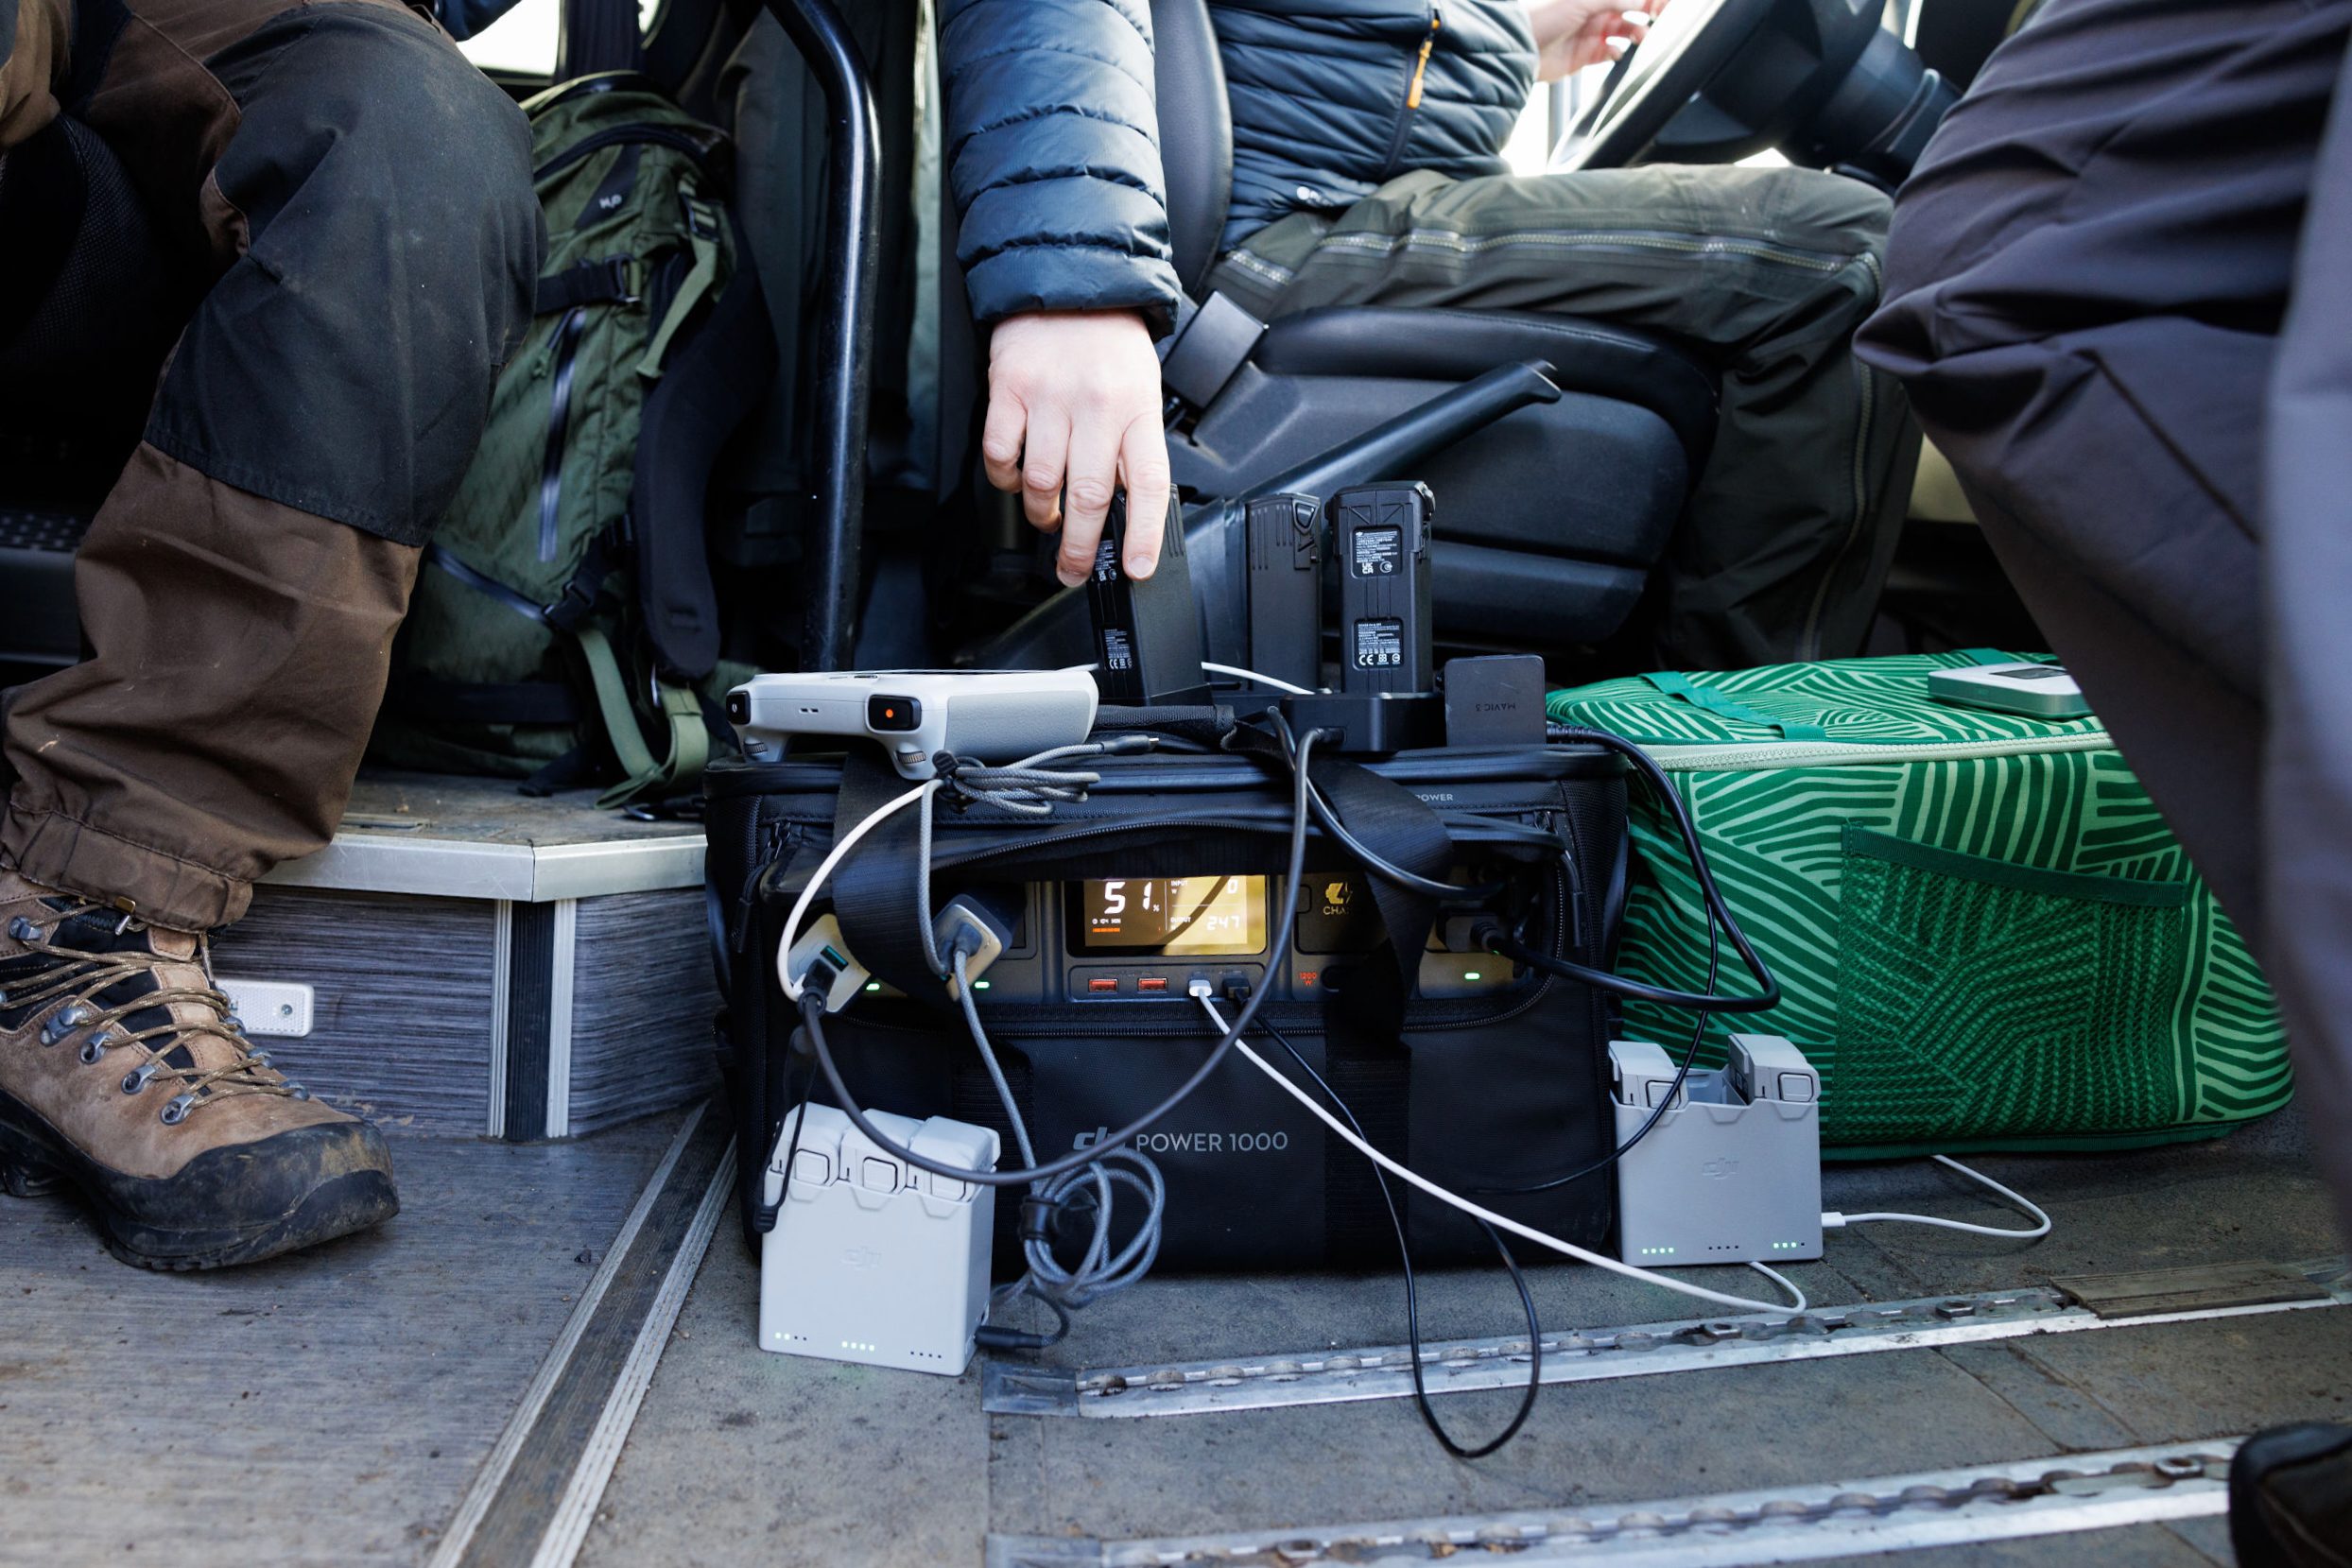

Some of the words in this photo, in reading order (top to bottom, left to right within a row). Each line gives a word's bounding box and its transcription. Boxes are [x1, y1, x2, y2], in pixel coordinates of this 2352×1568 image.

[1358, 654, 1374, 666] CE
[1485, 702, 1517, 712] MAVIC
[1206, 916, 1240, 931] 247
[1136, 1133, 1222, 1152] POWER
[1229, 1131, 1288, 1151] 1000
